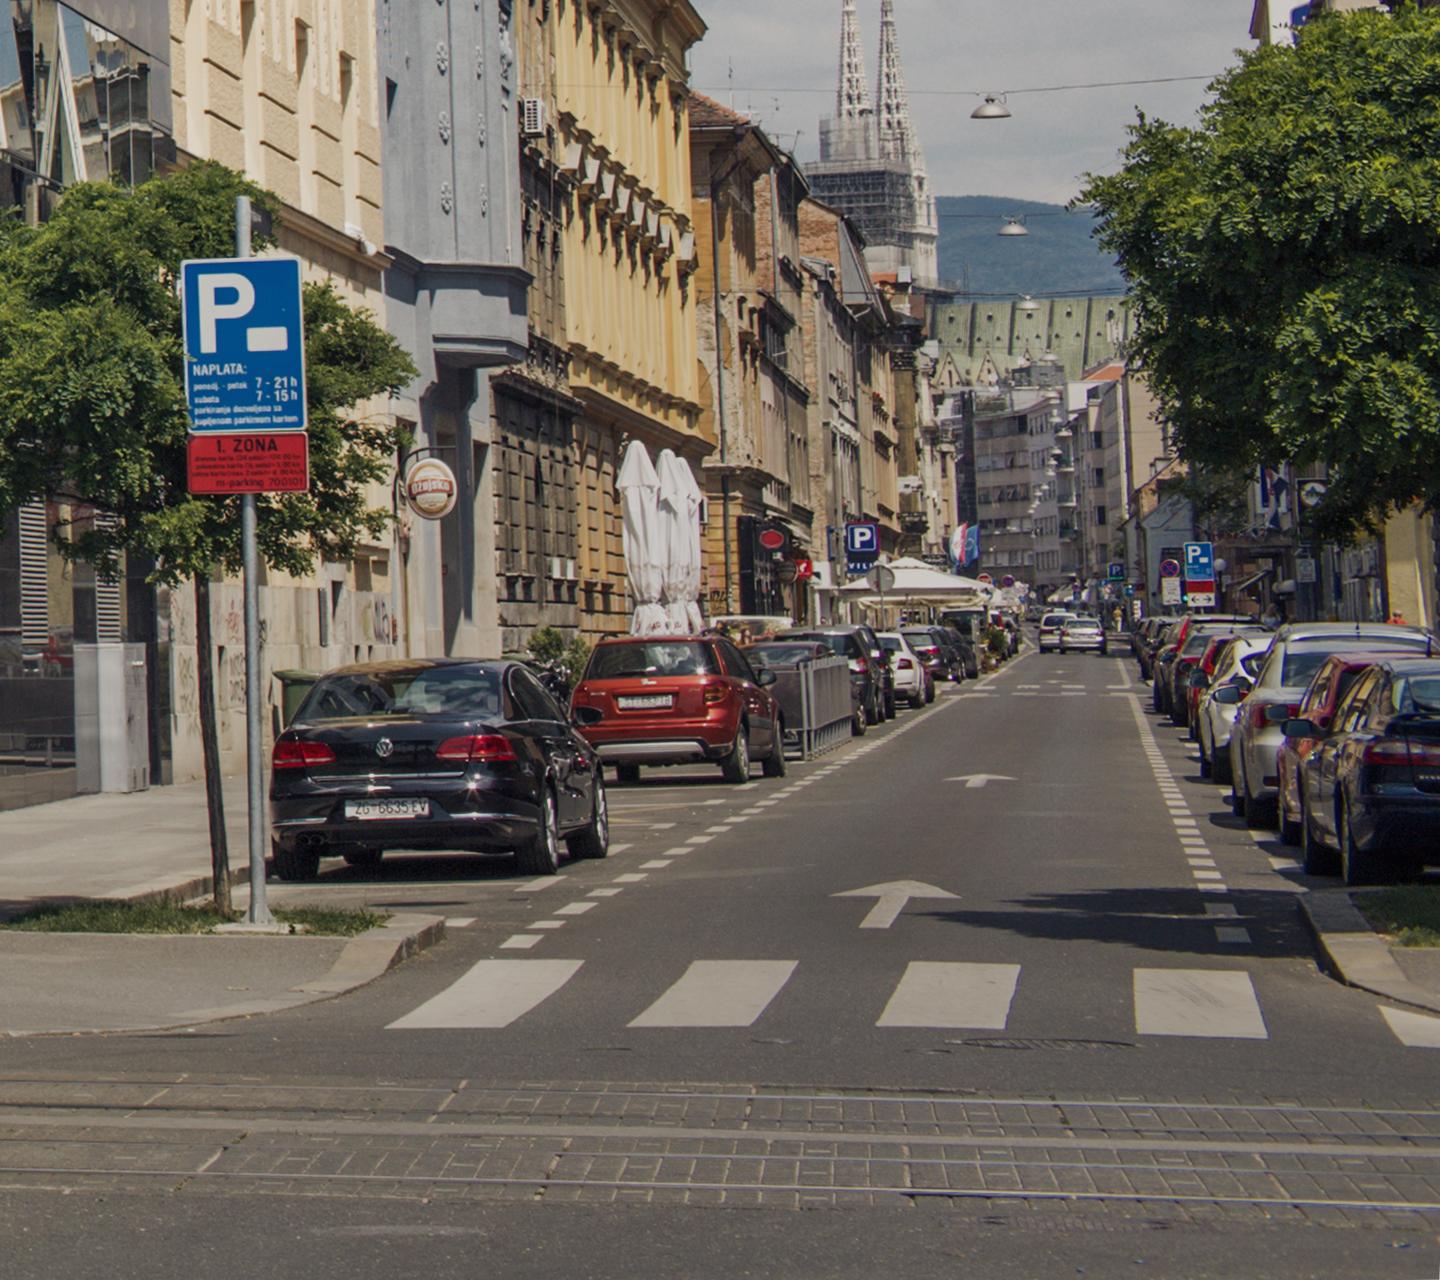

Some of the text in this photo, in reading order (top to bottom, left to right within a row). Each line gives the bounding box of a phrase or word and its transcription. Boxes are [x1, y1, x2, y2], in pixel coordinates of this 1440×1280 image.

[197, 272, 256, 354] P
[193, 363, 248, 376] NAPLATA:
[255, 376, 263, 389] 7
[274, 376, 288, 390] 21
[290, 376, 298, 388] h
[255, 390, 263, 402] 7
[274, 389, 289, 402] 15
[290, 389, 298, 401] h
[233, 437, 279, 453] ZONA
[853, 527, 872, 549] P
[1187, 545, 1202, 564] P
